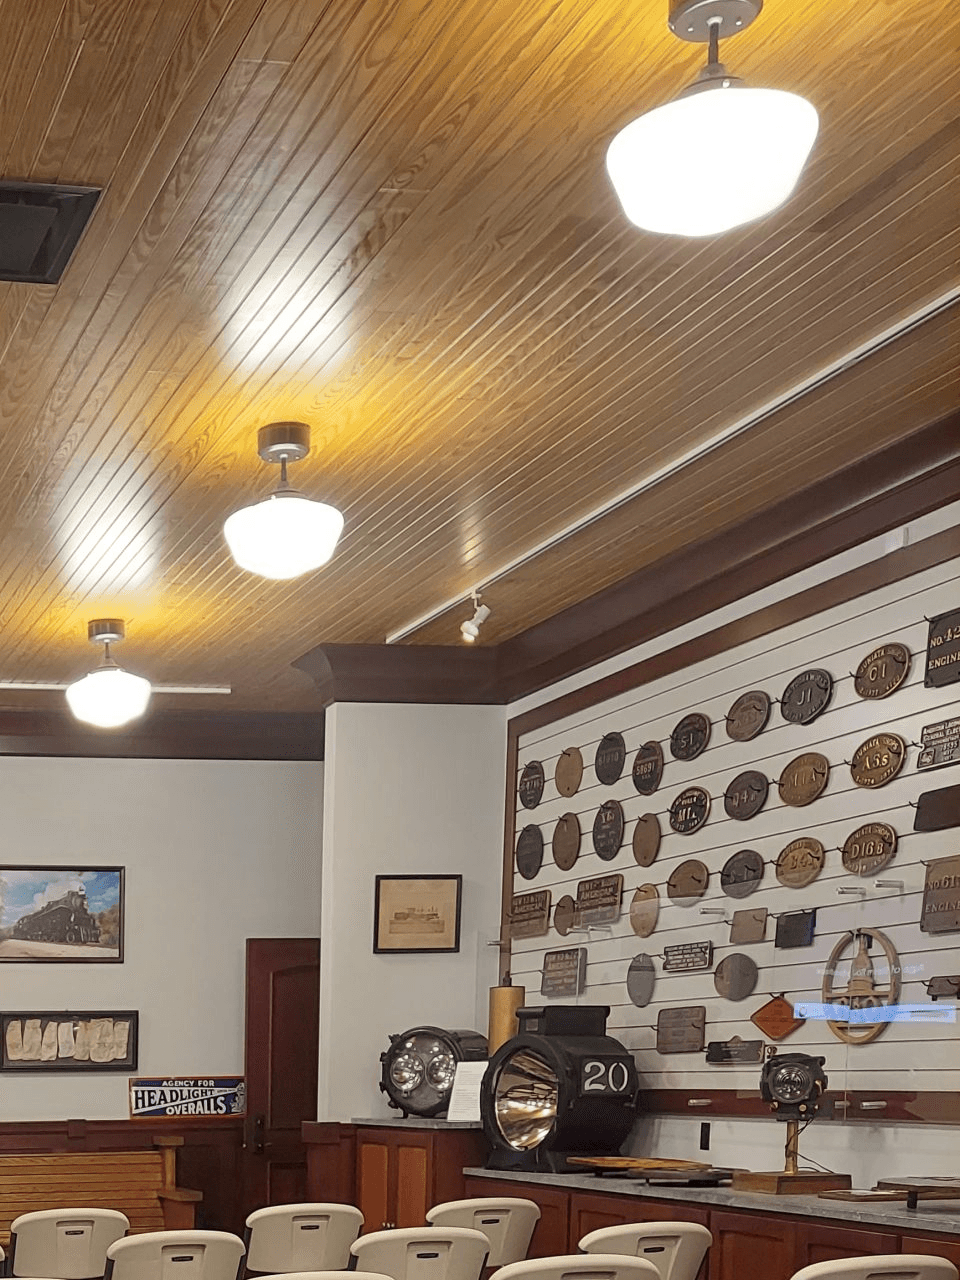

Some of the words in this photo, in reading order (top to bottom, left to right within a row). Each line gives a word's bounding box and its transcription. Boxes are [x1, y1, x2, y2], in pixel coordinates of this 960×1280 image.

[584, 1061, 628, 1092] 20
[134, 1089, 215, 1110] HEADLIGHT
[165, 1096, 227, 1115] OVERALLS
